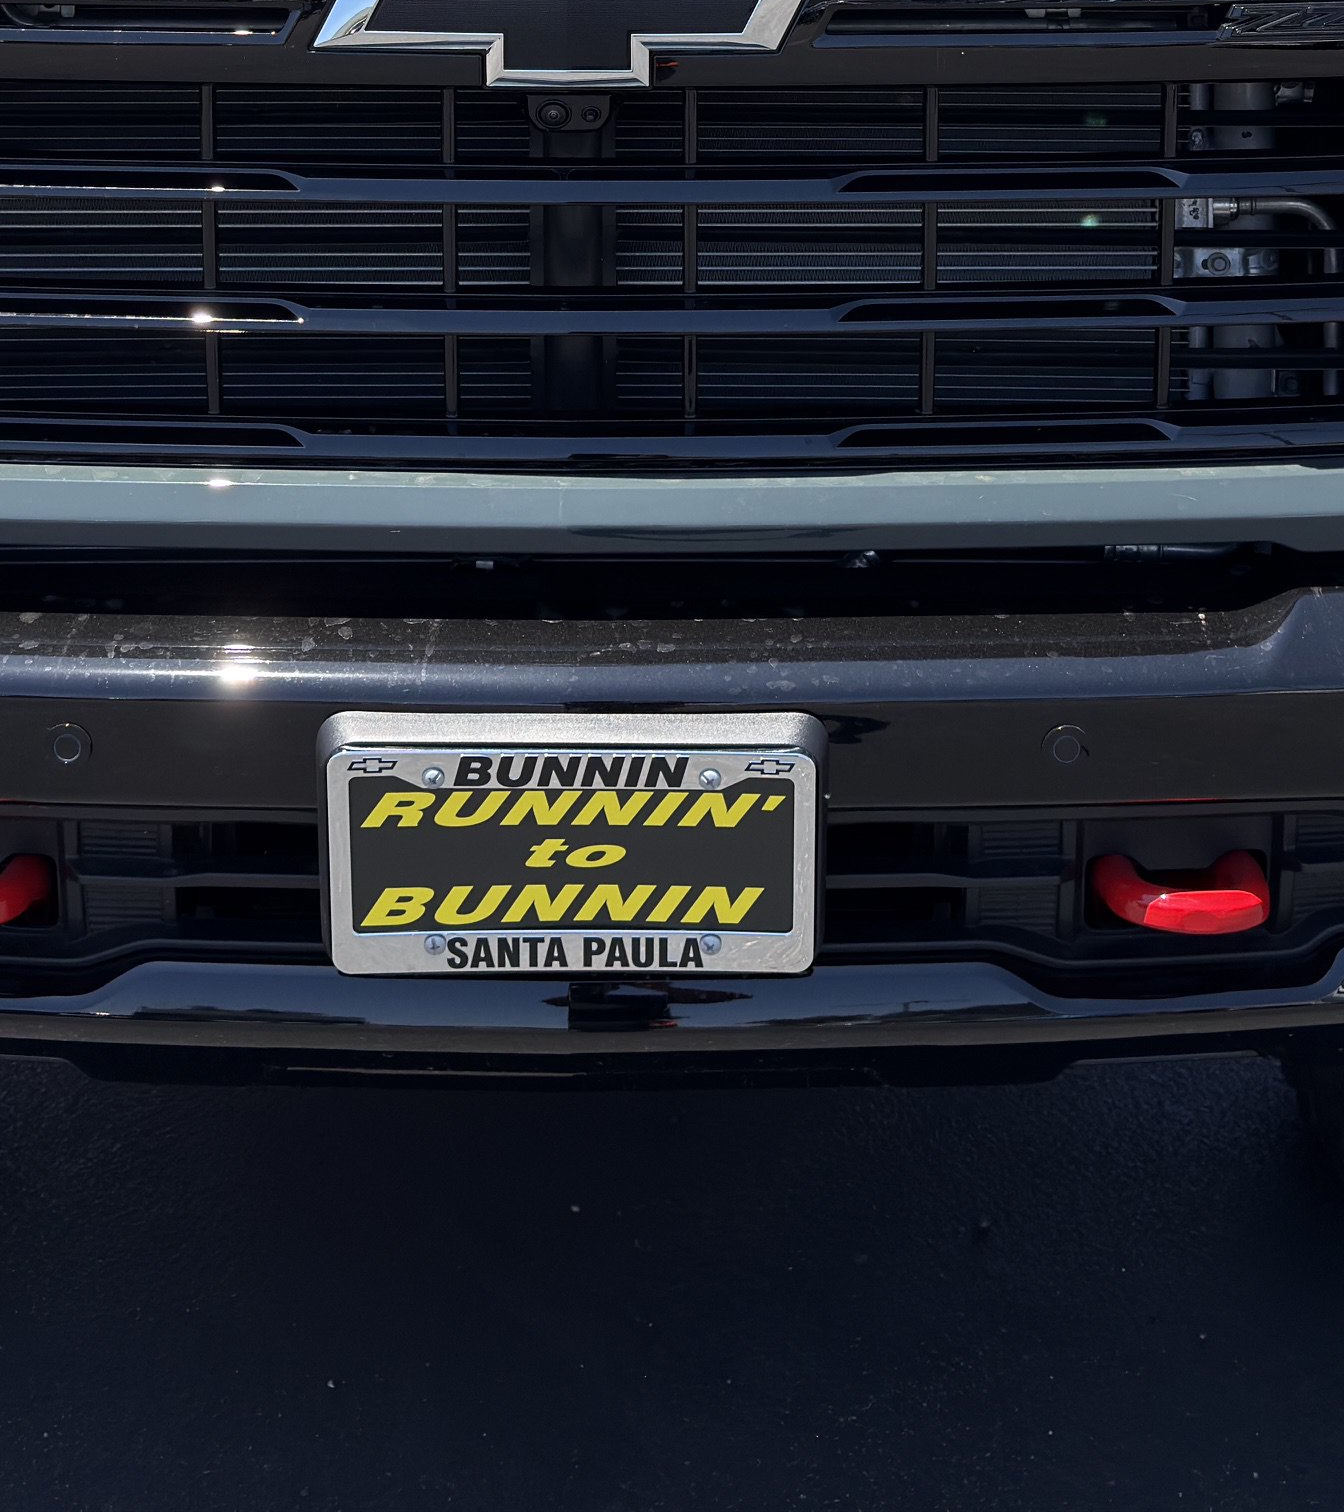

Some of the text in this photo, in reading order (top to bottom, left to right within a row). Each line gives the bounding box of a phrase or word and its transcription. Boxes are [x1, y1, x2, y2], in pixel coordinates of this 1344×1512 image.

[453, 755, 690, 788] BUNNIN
[360, 791, 786, 828] RUNNIN'
[525, 838, 627, 868] to
[360, 884, 765, 927] BUNNIN
[446, 936, 705, 970] SANTA PAULA
